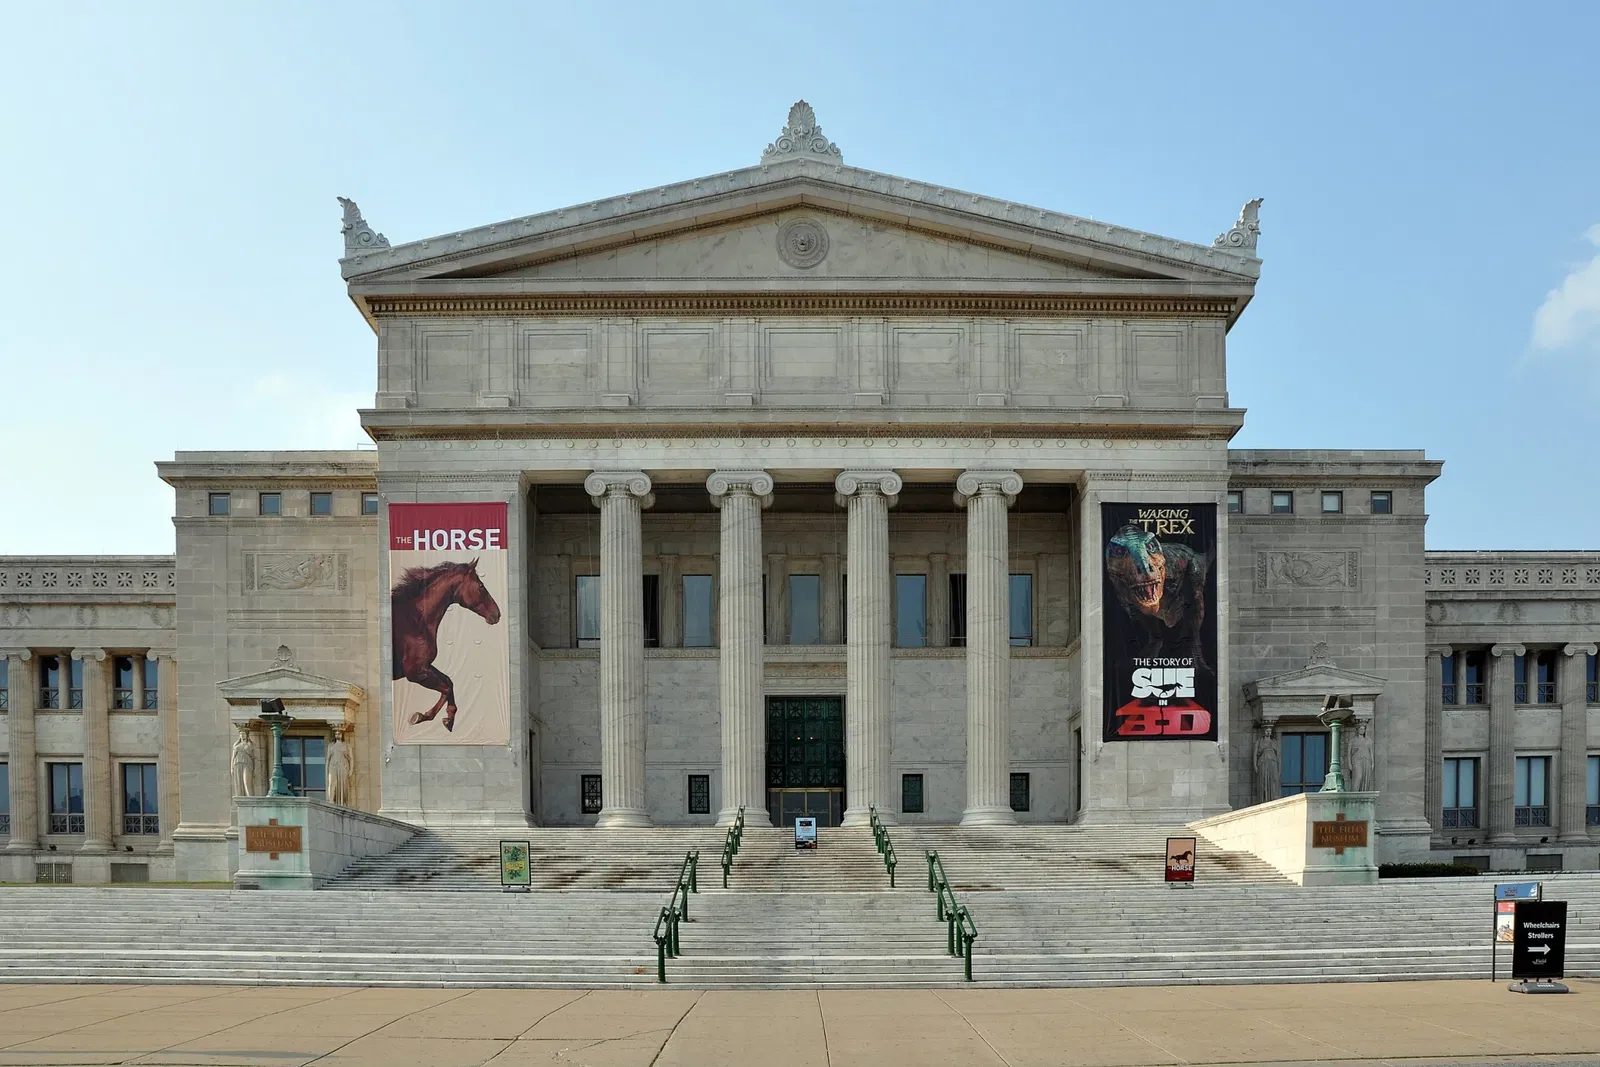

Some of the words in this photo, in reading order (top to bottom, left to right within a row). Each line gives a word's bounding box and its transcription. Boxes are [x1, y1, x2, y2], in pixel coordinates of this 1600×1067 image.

[1138, 509, 1189, 518] WAKING
[396, 536, 412, 544] THE
[414, 529, 500, 550] HORSE
[1133, 657, 1152, 666] THE
[1152, 657, 1181, 667] STORY
[1181, 657, 1194, 666] OF
[1131, 667, 1195, 699] SUE
